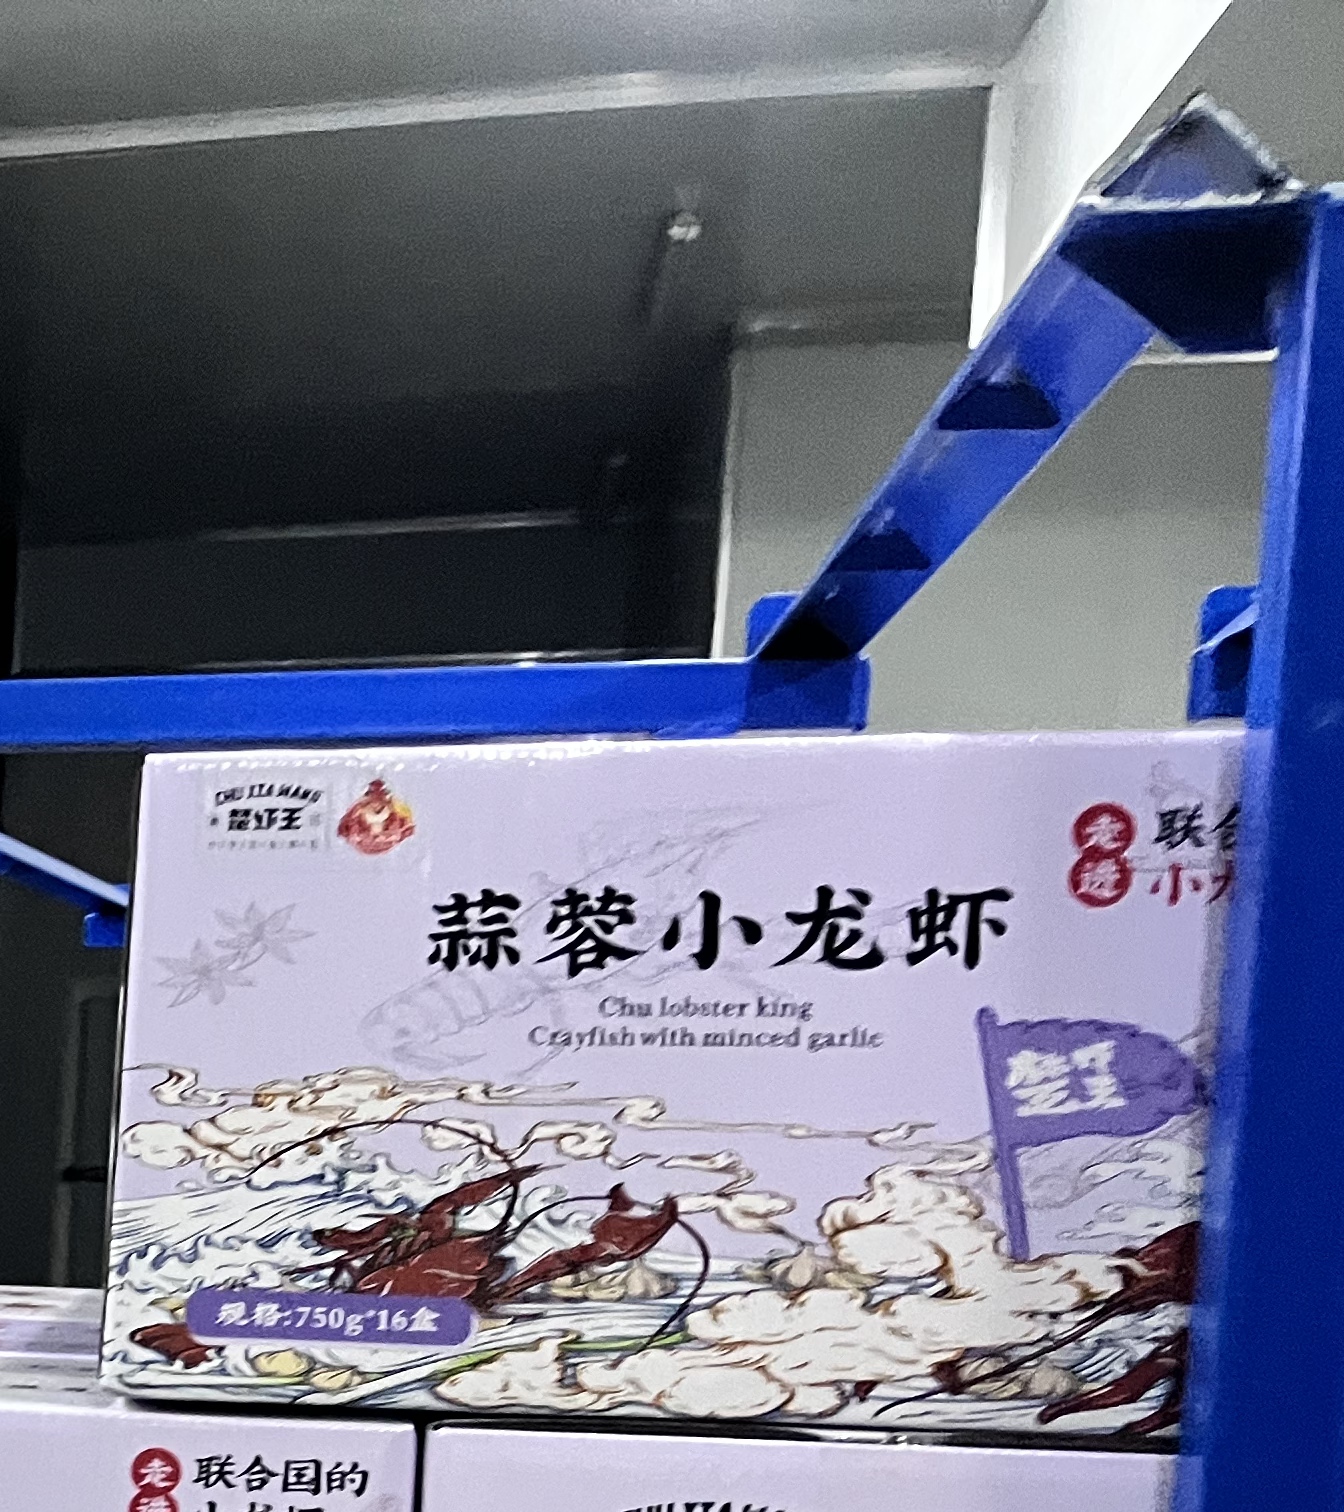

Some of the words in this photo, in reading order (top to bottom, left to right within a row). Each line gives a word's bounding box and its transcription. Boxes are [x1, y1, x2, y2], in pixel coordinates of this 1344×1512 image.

[427, 885, 1014, 979] 蒜蓉小龙虾
[598, 995, 653, 1018] Chu
[658, 995, 749, 1018] lobster
[755, 996, 814, 1022] king
[528, 1025, 636, 1053] Crayfish
[639, 1026, 695, 1048] with
[701, 1027, 801, 1049] minced
[806, 1026, 885, 1053] garlic
[192, 1454, 370, 1498] 联合国的
